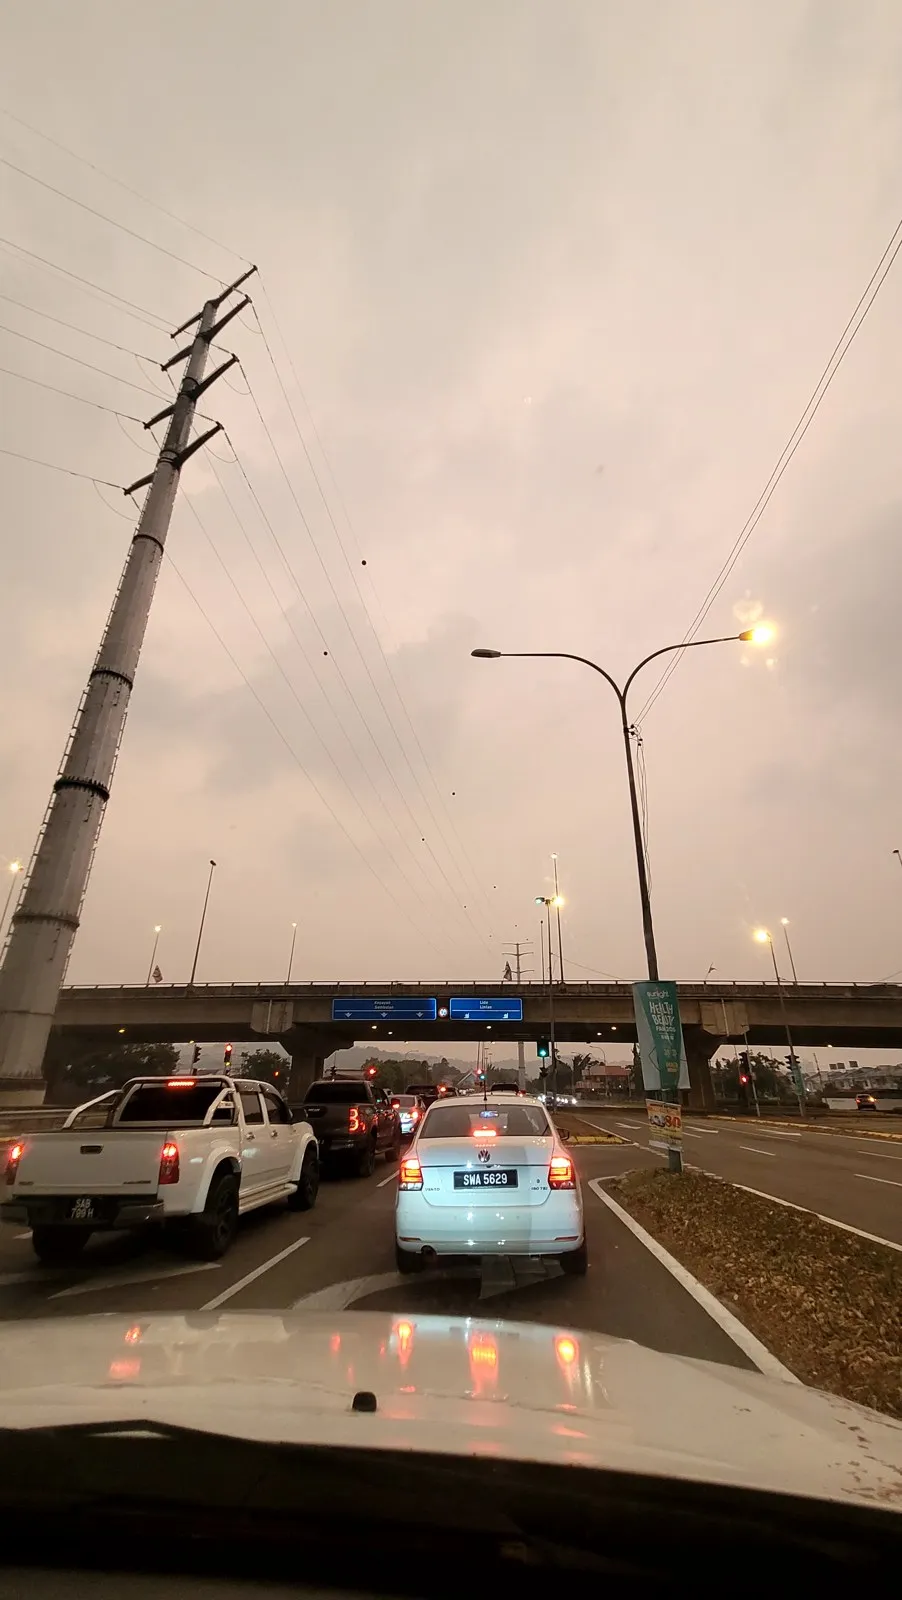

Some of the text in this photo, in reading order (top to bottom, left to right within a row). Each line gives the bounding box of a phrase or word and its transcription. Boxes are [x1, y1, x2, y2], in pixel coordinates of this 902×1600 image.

[649, 1001, 673, 1015] HEALTH
[651, 1014, 675, 1026] BEAUTY
[463, 1173, 508, 1186] SWA 5629
[75, 1198, 91, 1209] SAB
